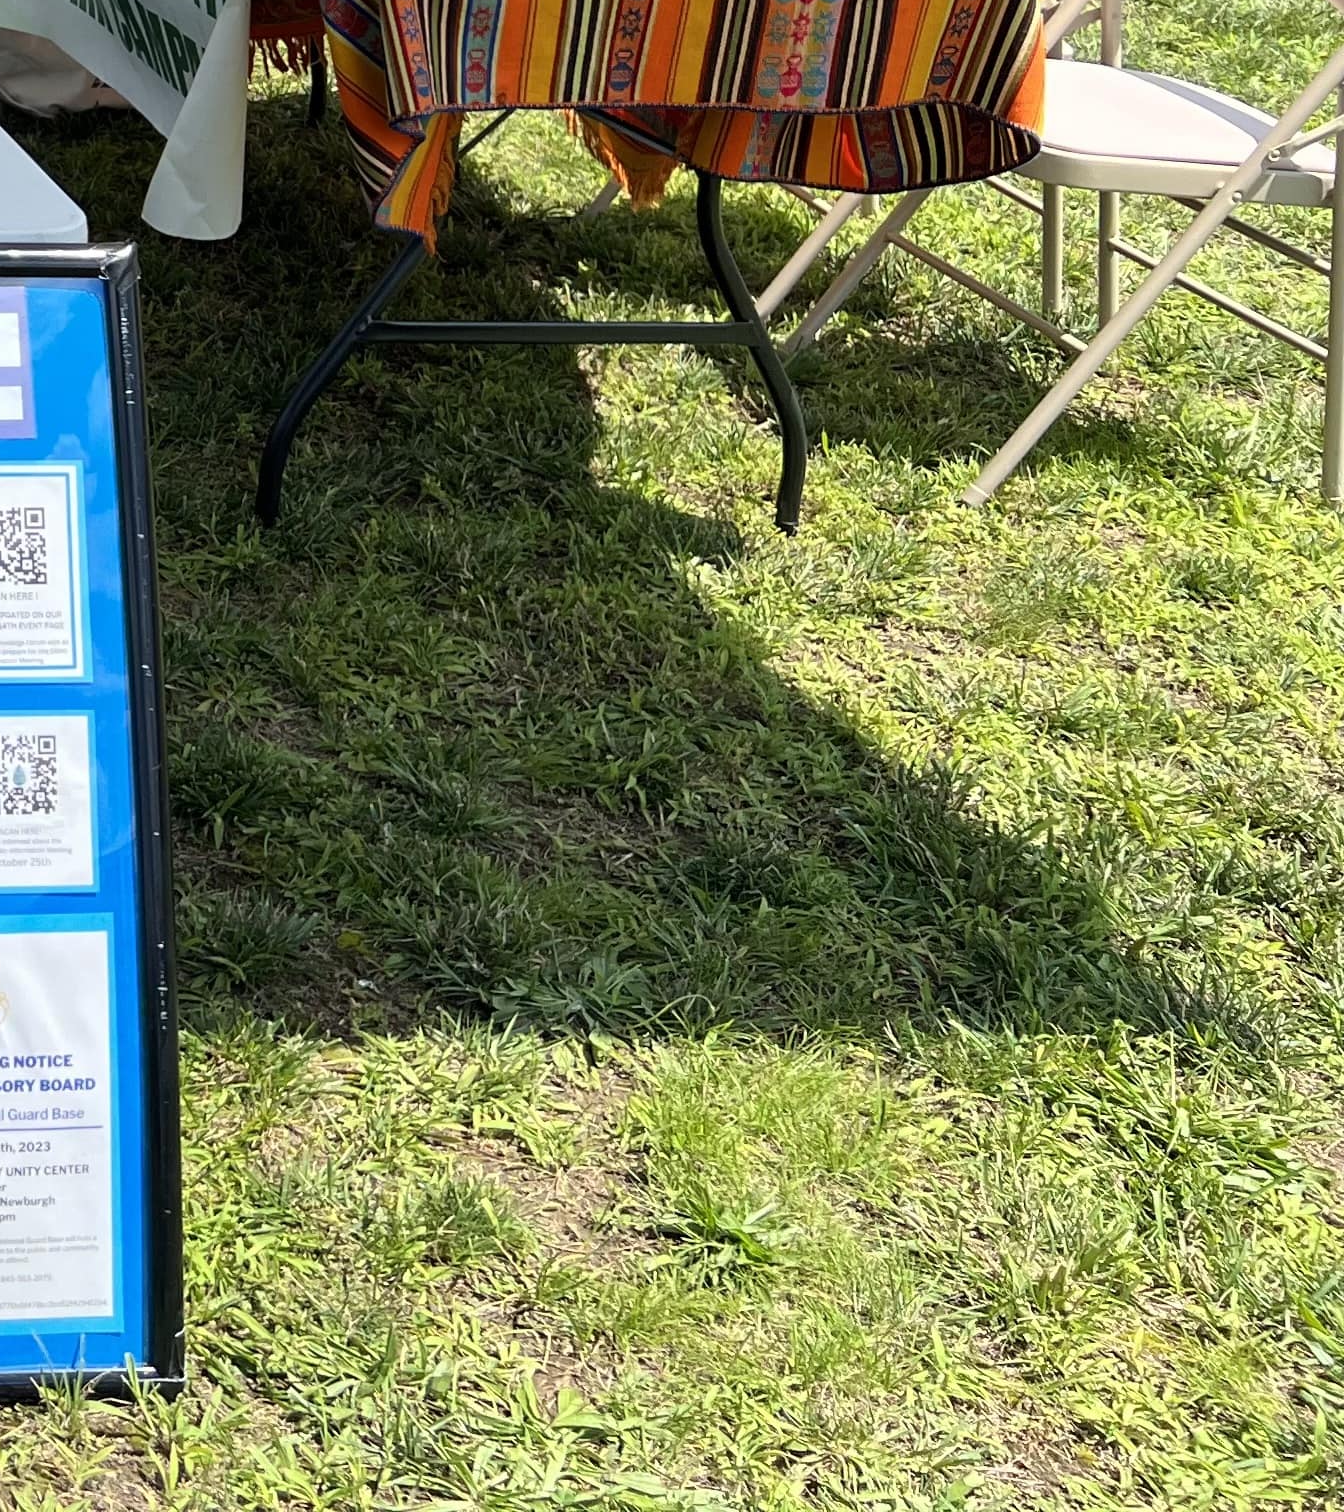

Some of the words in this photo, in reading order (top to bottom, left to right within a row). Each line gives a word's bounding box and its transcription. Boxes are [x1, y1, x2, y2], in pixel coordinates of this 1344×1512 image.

[13, 1054, 72, 1068] NOTICE
[40, 1078, 95, 1091] BOARD
[7, 1107, 48, 1120] Guard
[52, 1106, 84, 1119] Base
[18, 1141, 50, 1152] 2023
[6, 1166, 40, 1176] UNITY
[43, 1164, 88, 1175] CENTER
[0, 1195, 55, 1208] Newburgh
